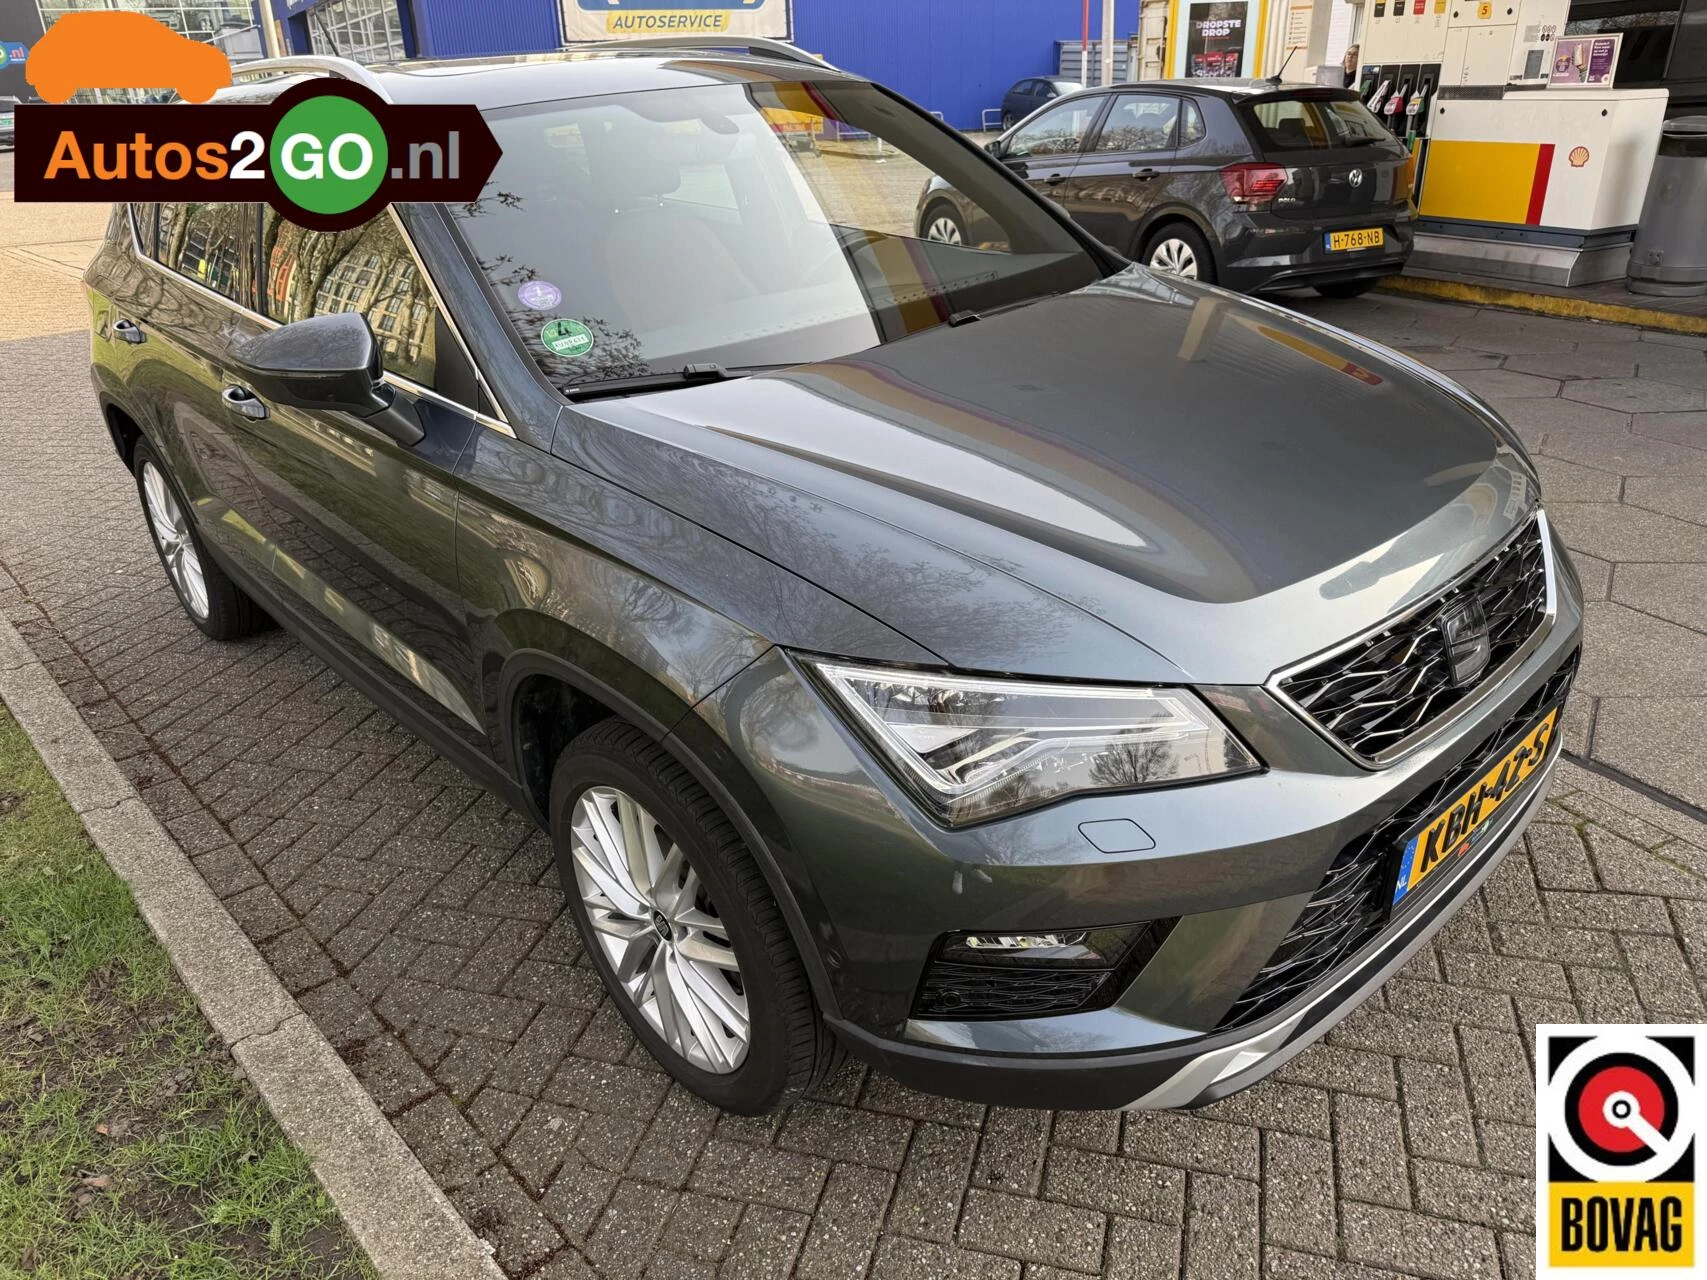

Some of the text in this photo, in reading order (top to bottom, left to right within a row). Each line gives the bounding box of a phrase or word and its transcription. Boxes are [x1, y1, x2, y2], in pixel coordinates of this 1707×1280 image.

[1481, 6, 1488, 15] 5
[613, 15, 723, 29] AUTOSERVICE
[1195, 19, 1242, 30] DROPSTE
[1201, 28, 1231, 37] DROP
[1333, 230, 1380, 249] H-768-NB
[1420, 722, 1549, 873] KBH-42-S
